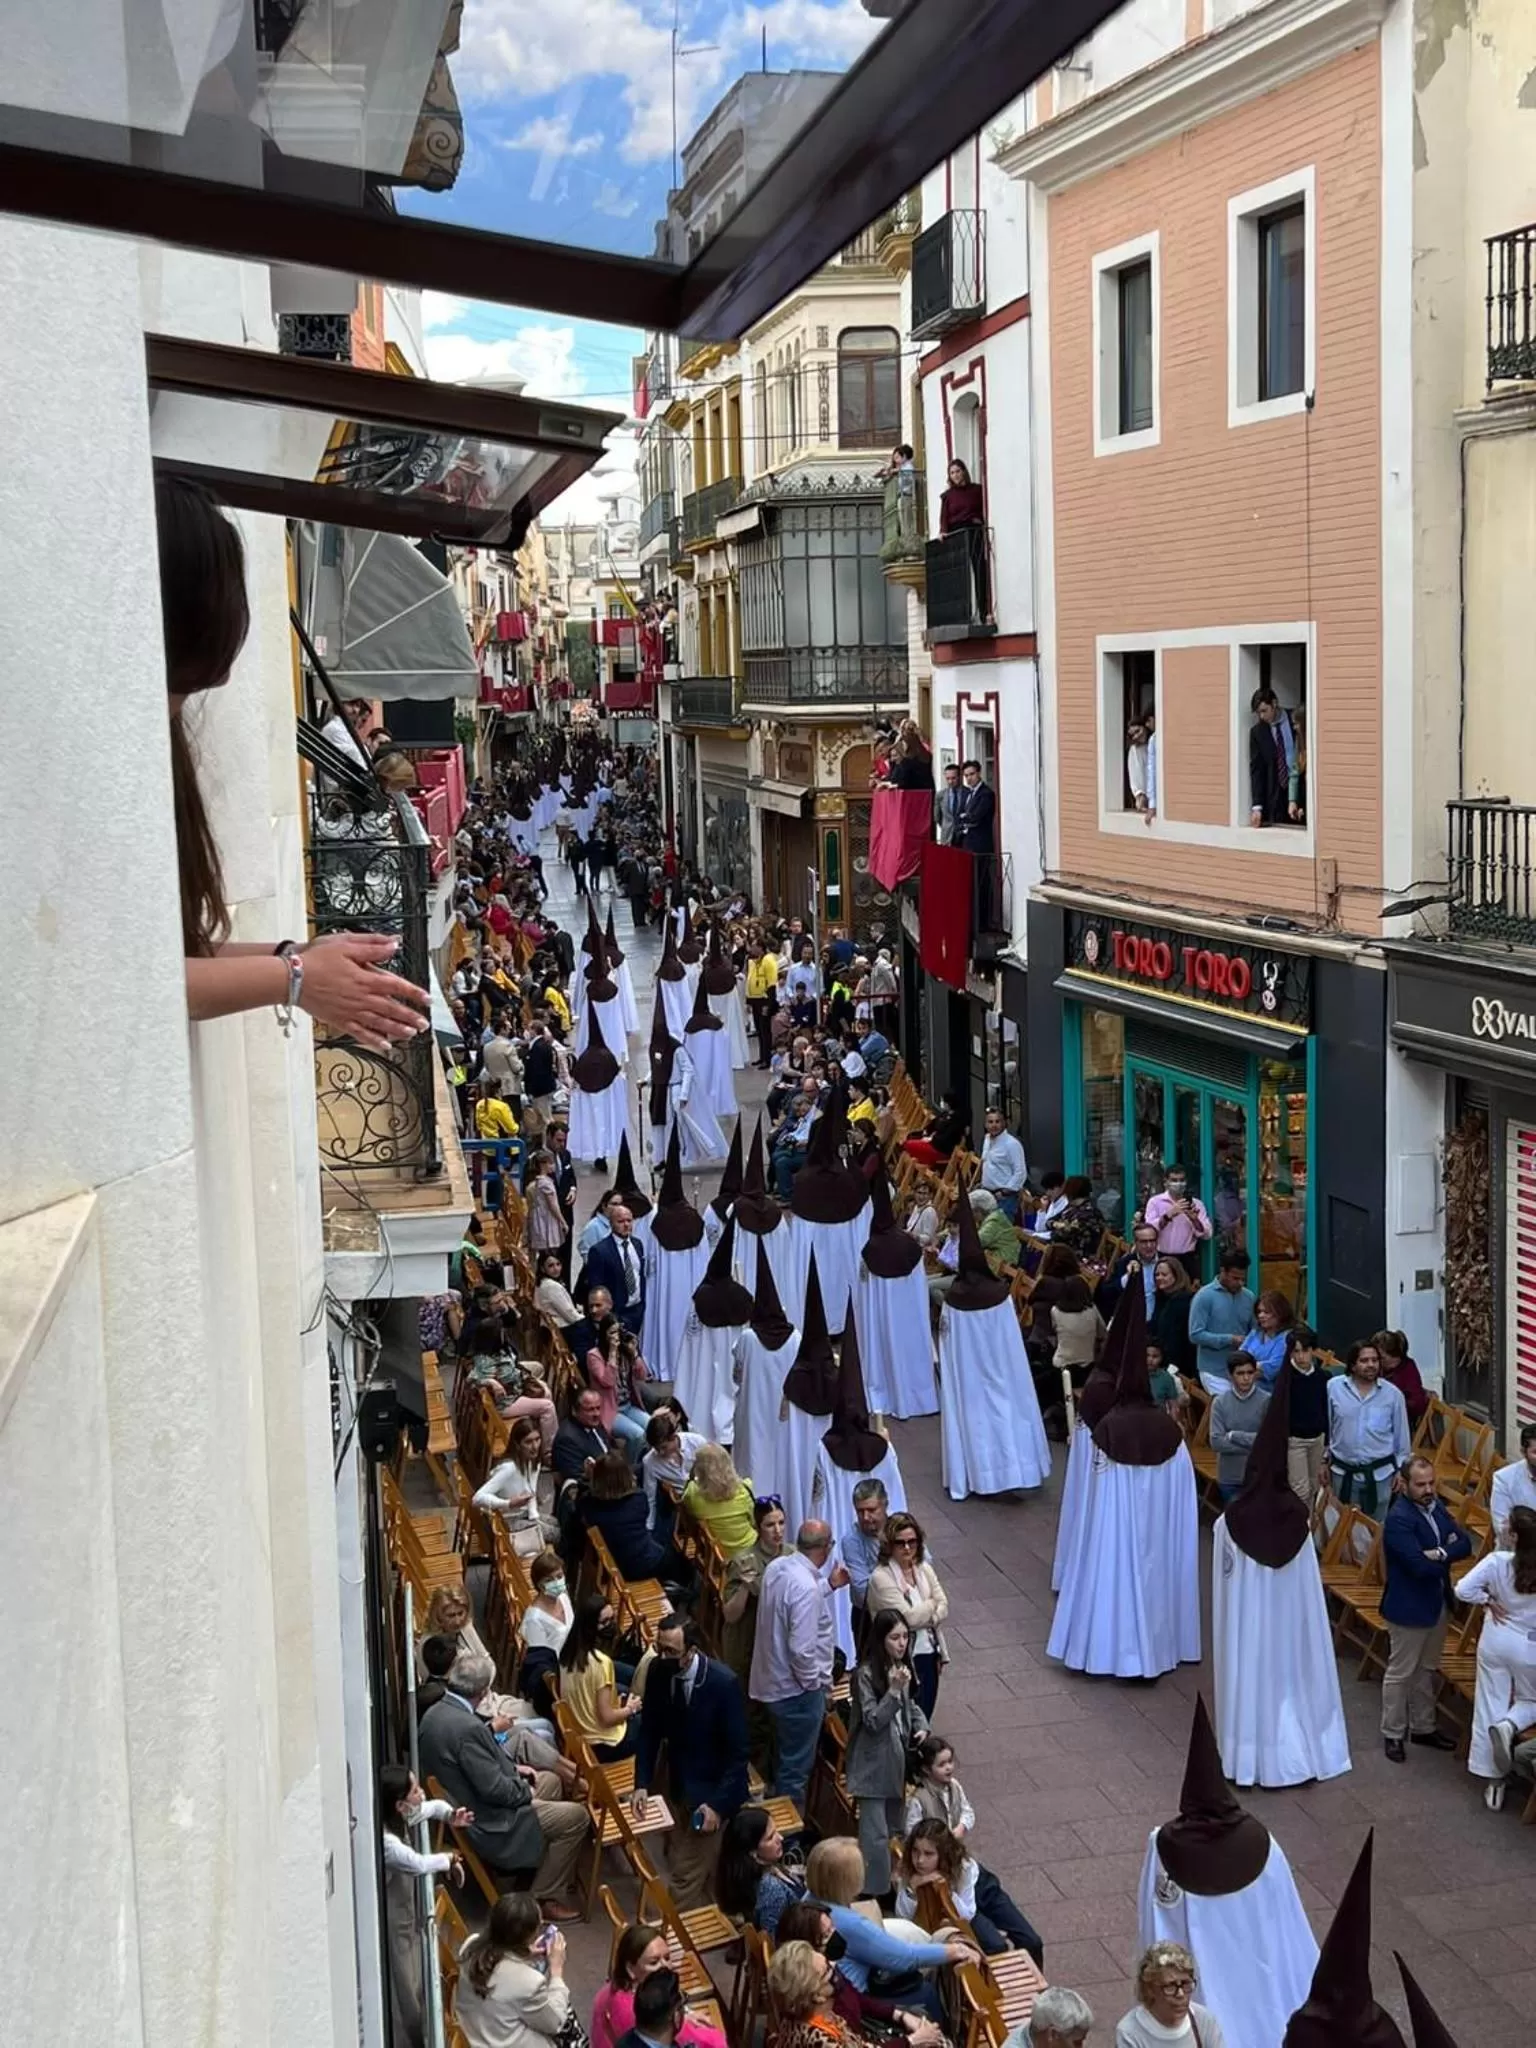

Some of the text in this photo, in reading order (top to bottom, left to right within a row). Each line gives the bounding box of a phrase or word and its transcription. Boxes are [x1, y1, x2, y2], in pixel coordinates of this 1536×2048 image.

[1111, 930, 1250, 999] TORO TORO
[1503, 1010, 1536, 1039] VAL
